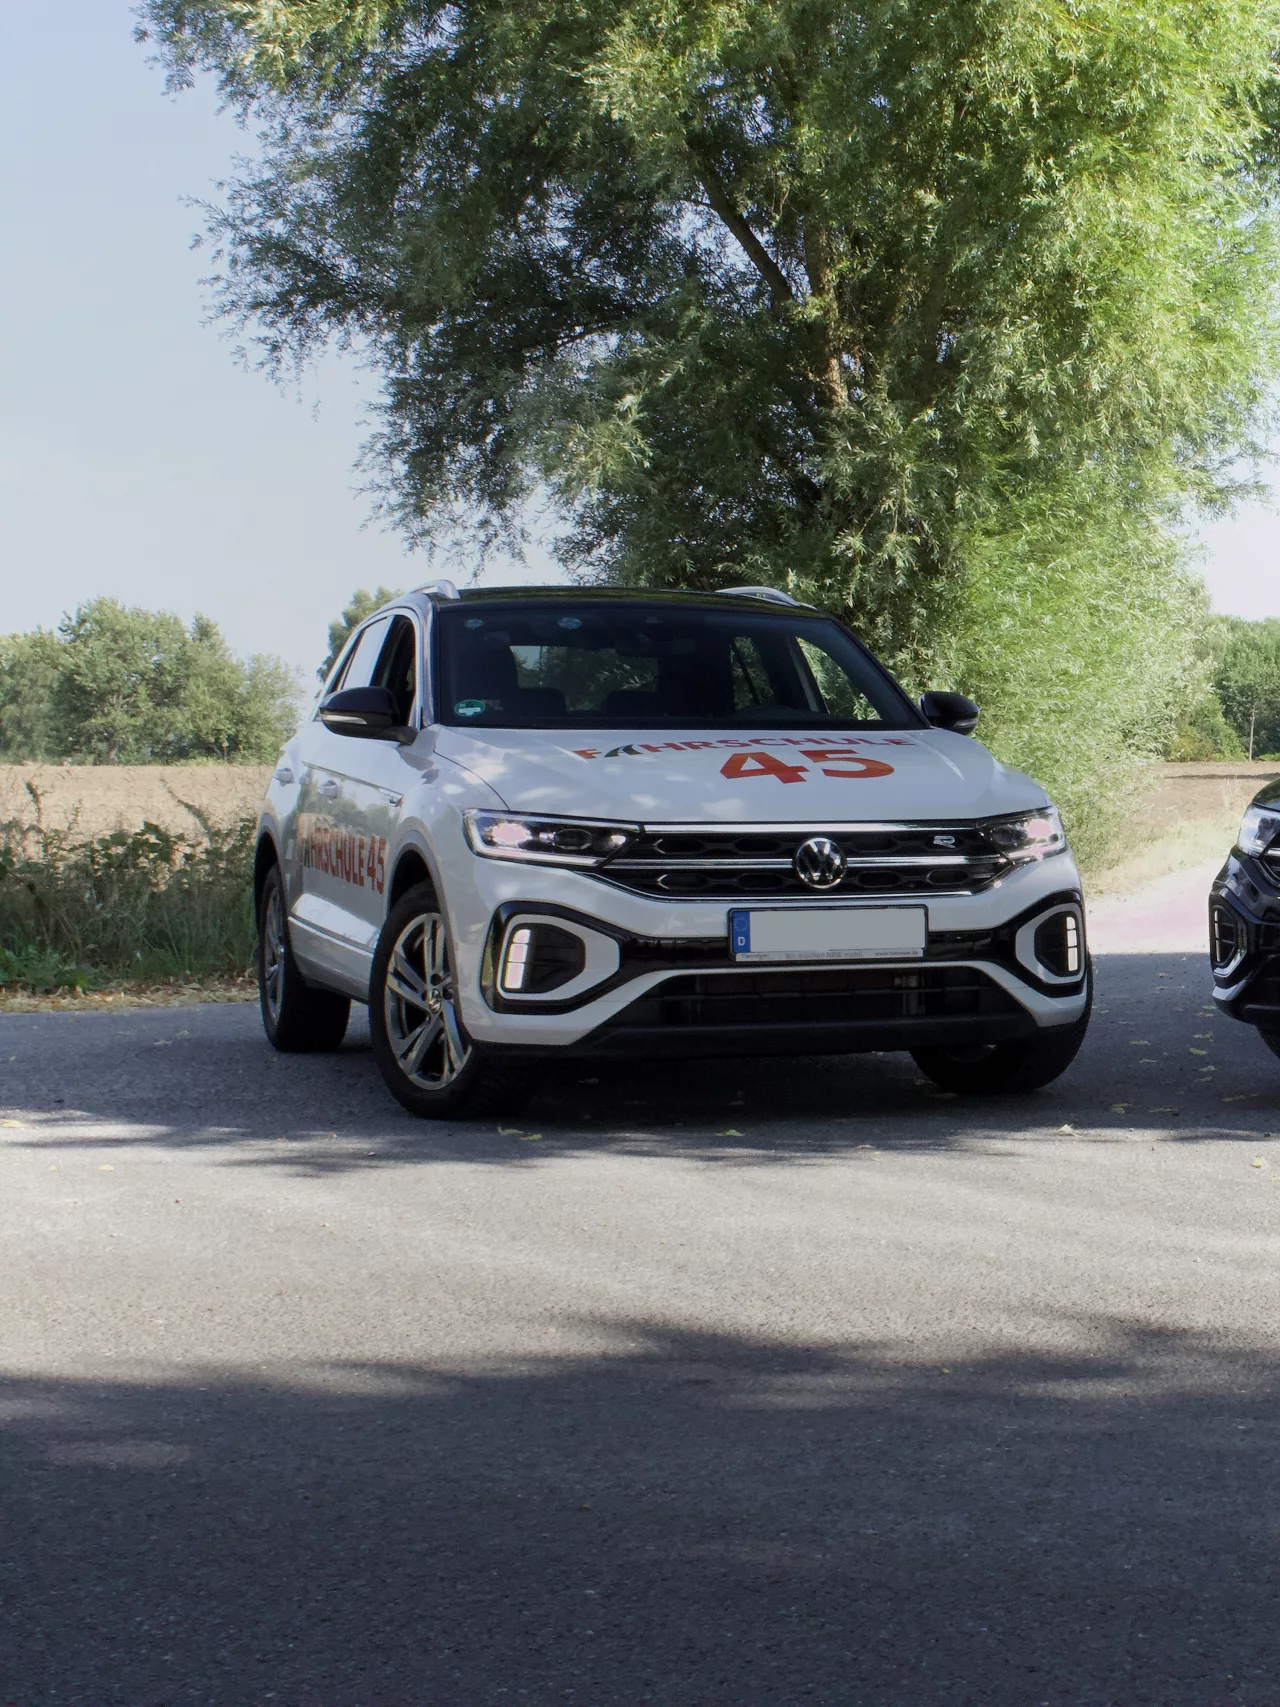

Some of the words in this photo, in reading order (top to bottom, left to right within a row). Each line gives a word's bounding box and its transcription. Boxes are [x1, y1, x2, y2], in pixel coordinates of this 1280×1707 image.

[573, 737, 917, 760] FAHRSCHULE
[719, 749, 895, 784] 45
[366, 835, 387, 895] 45
[737, 936, 746, 947] D
